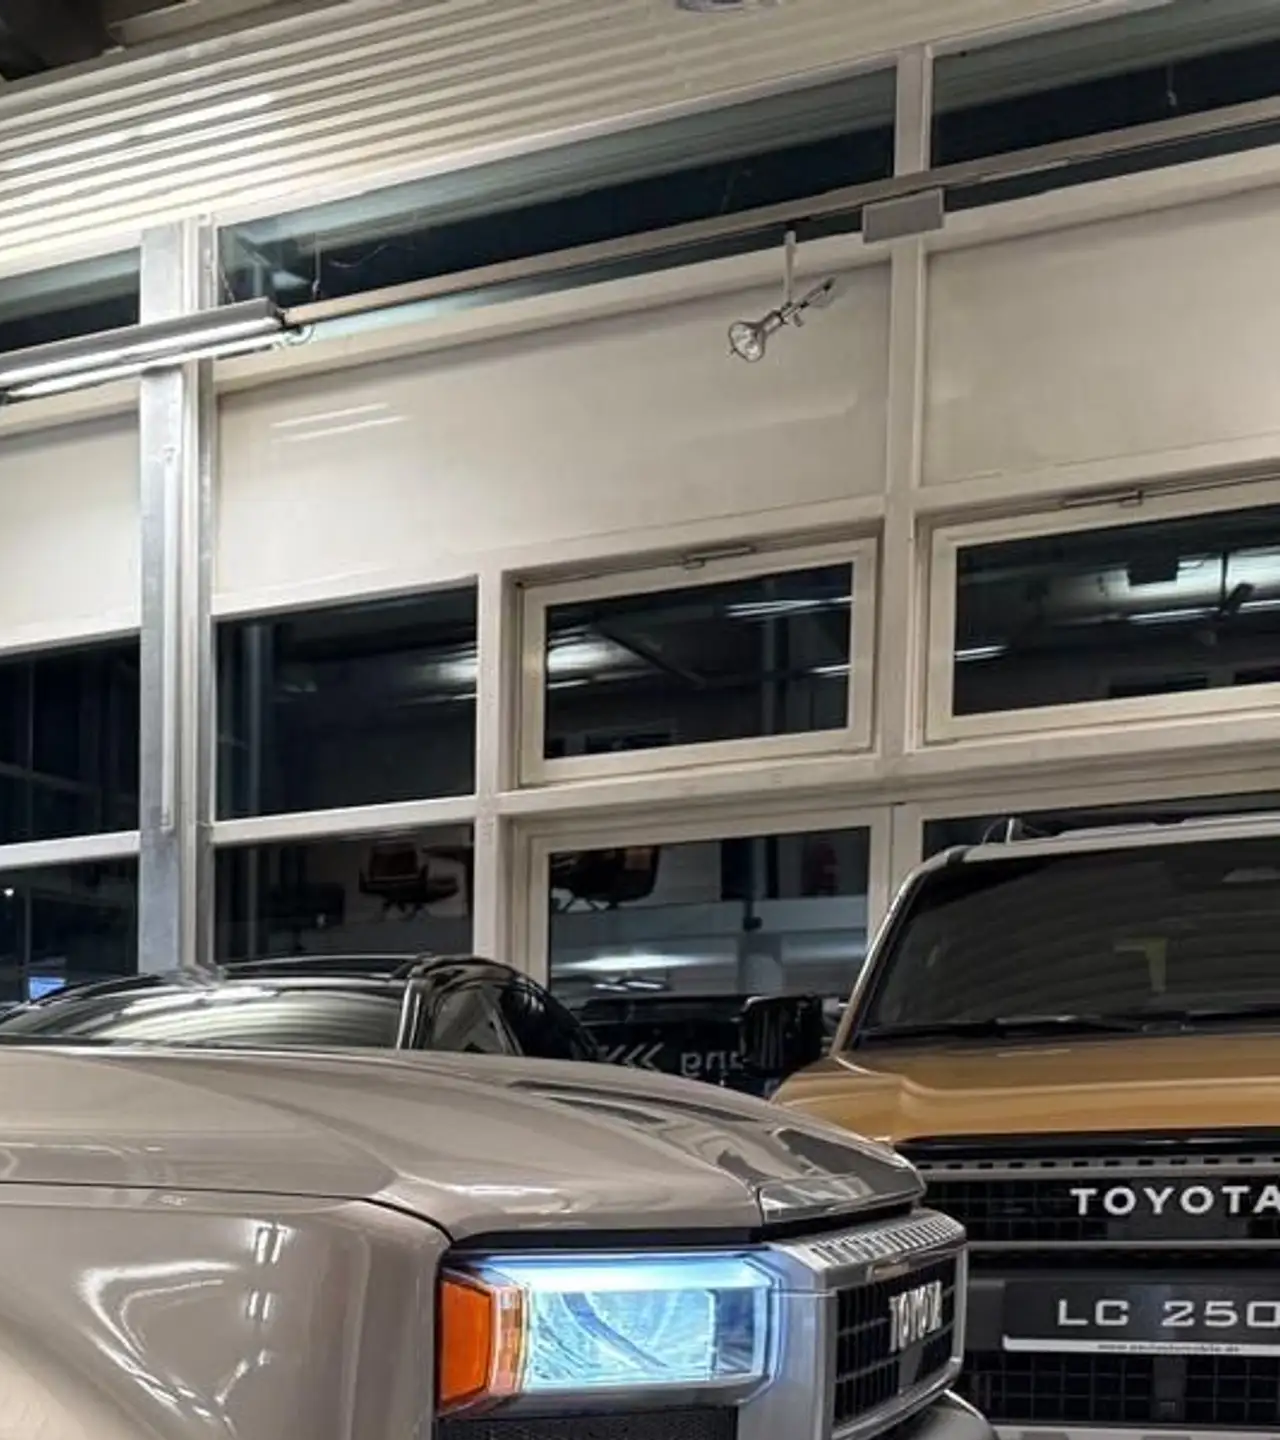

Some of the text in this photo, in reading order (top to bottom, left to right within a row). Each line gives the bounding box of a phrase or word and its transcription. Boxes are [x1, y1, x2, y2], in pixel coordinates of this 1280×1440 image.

[1071, 1186, 1280, 1215] TOYOTA
[889, 1280, 942, 1352] TOYOTA
[1058, 1299, 1280, 1327] LC 250
